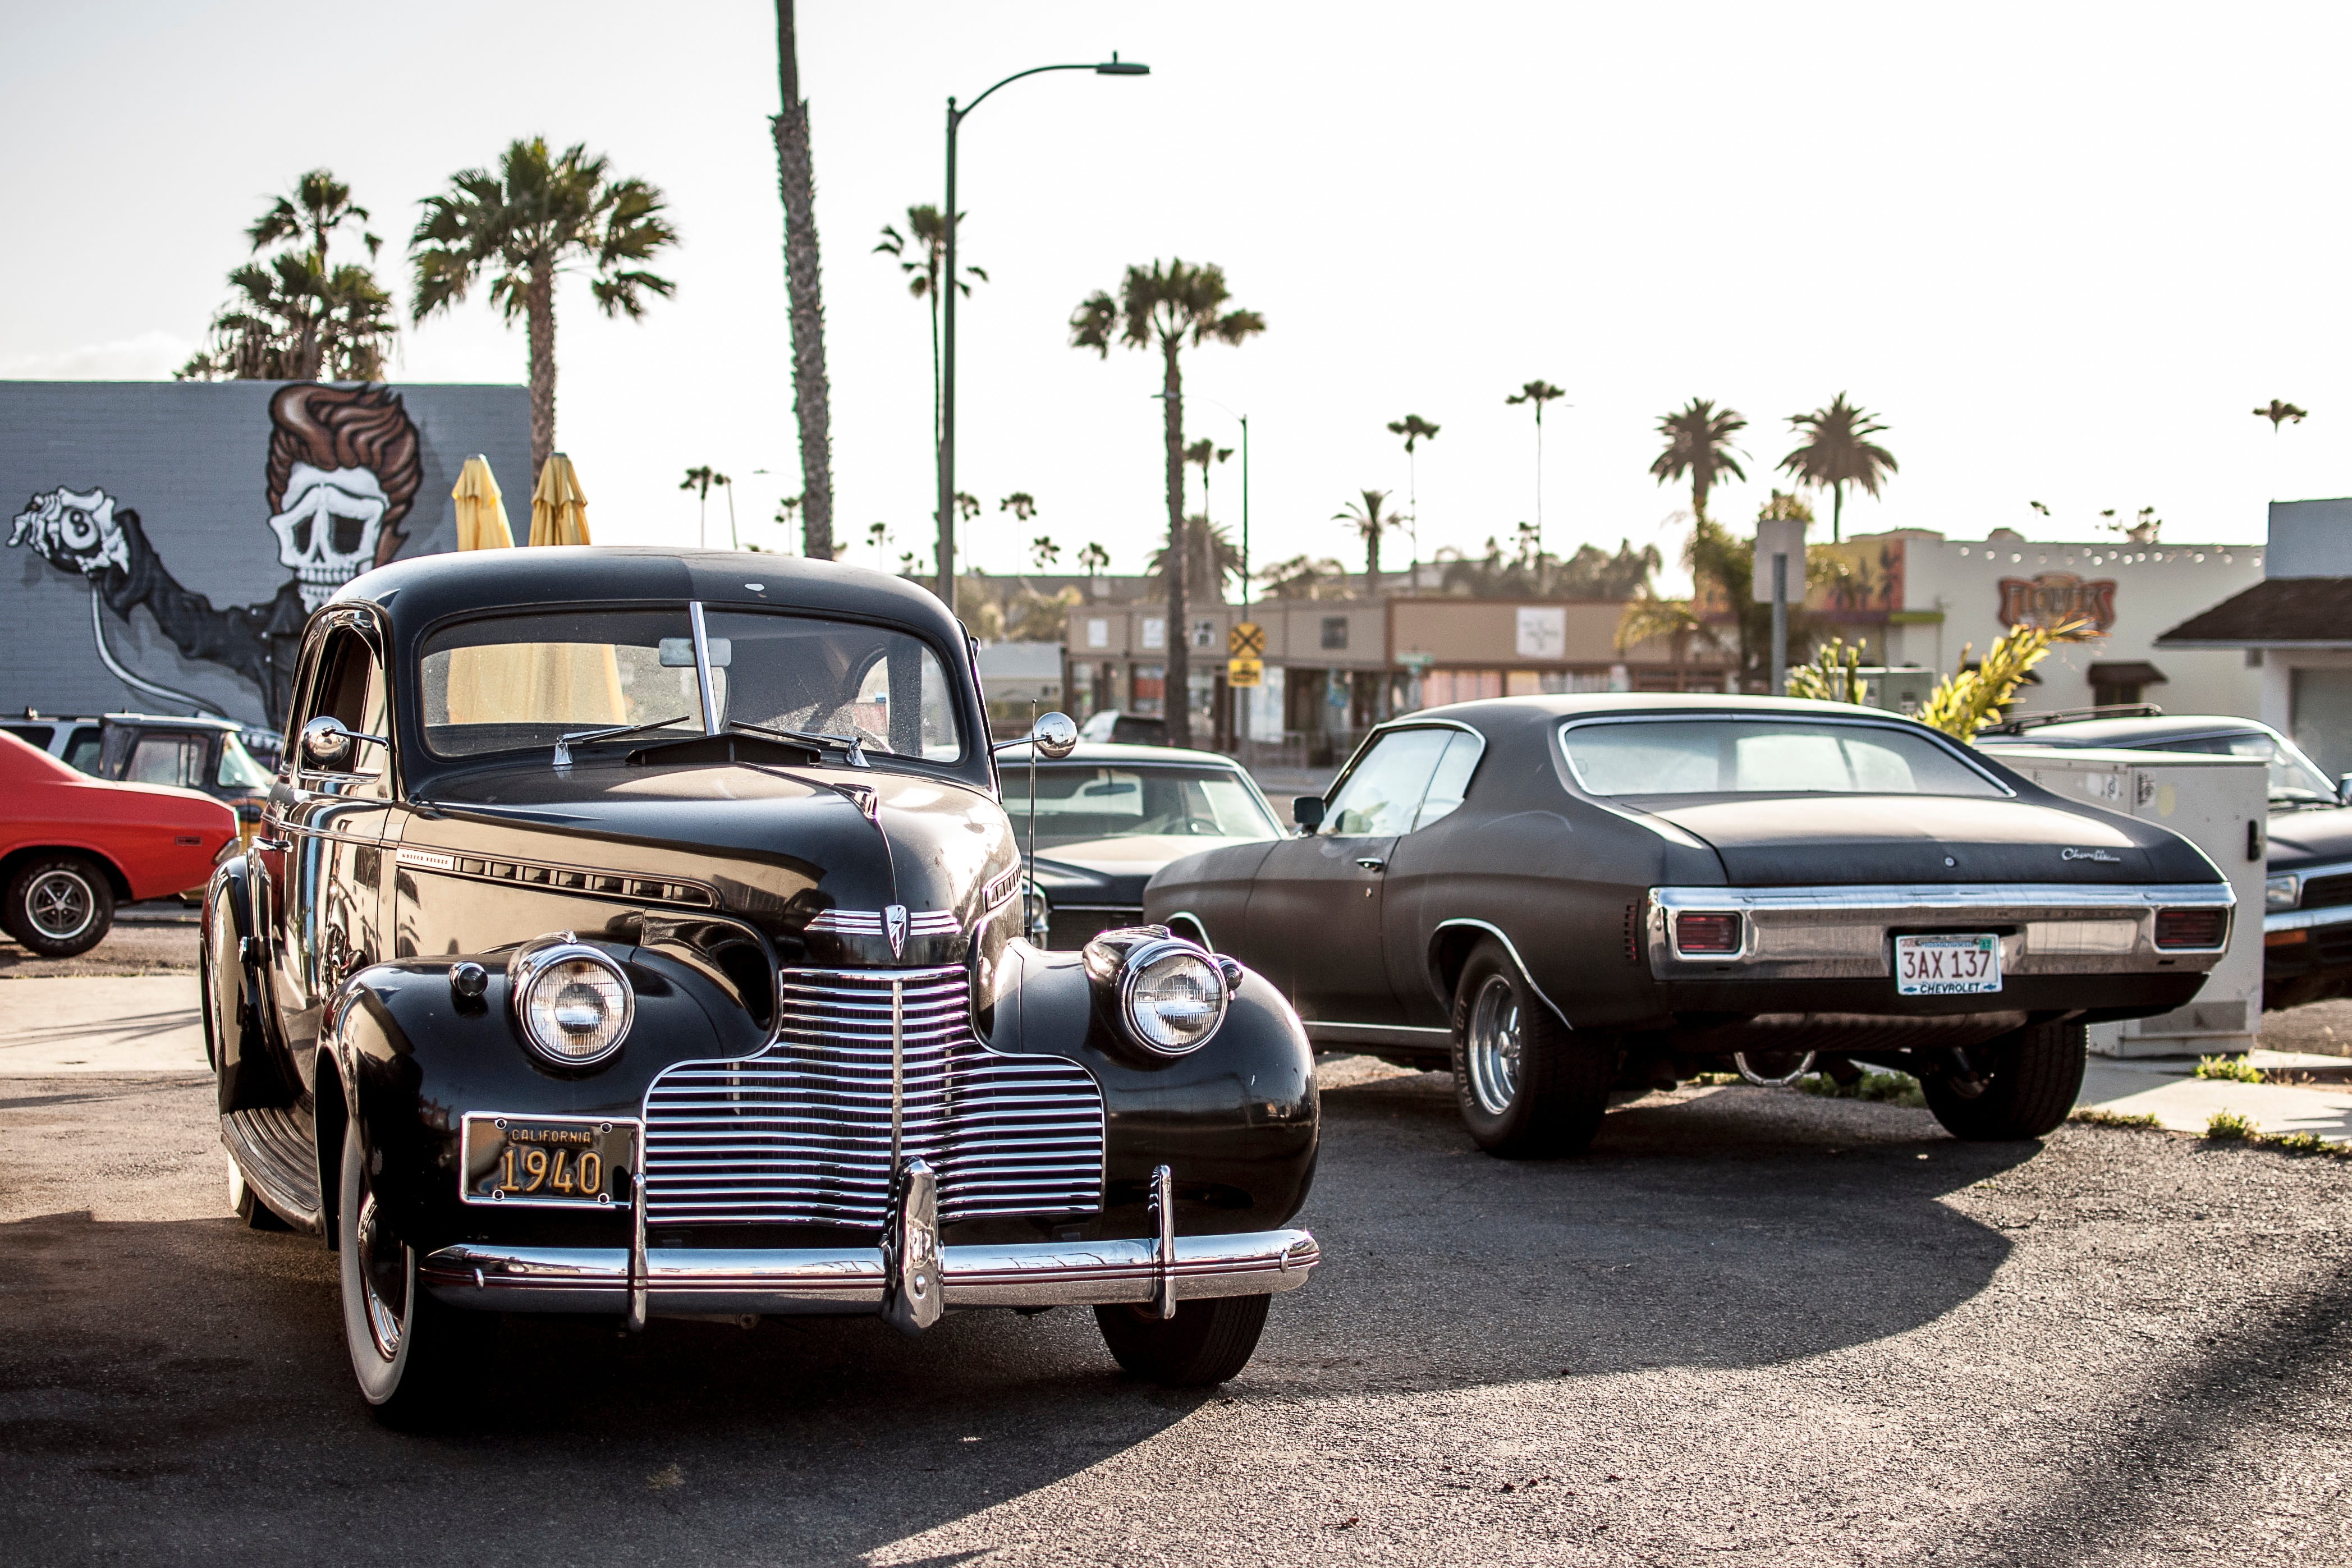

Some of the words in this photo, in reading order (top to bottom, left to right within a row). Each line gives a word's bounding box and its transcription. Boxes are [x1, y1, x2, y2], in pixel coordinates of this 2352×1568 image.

[70, 510, 90, 537] 8
[1903, 951, 1944, 979] 3AX
[1951, 950, 1991, 979] 137
[1920, 983, 1981, 993] CHEVROLET
[1455, 1038, 1474, 1108] RADIAL
[511, 1129, 592, 1144] CALIFORNIA
[498, 1149, 601, 1194] 1940
